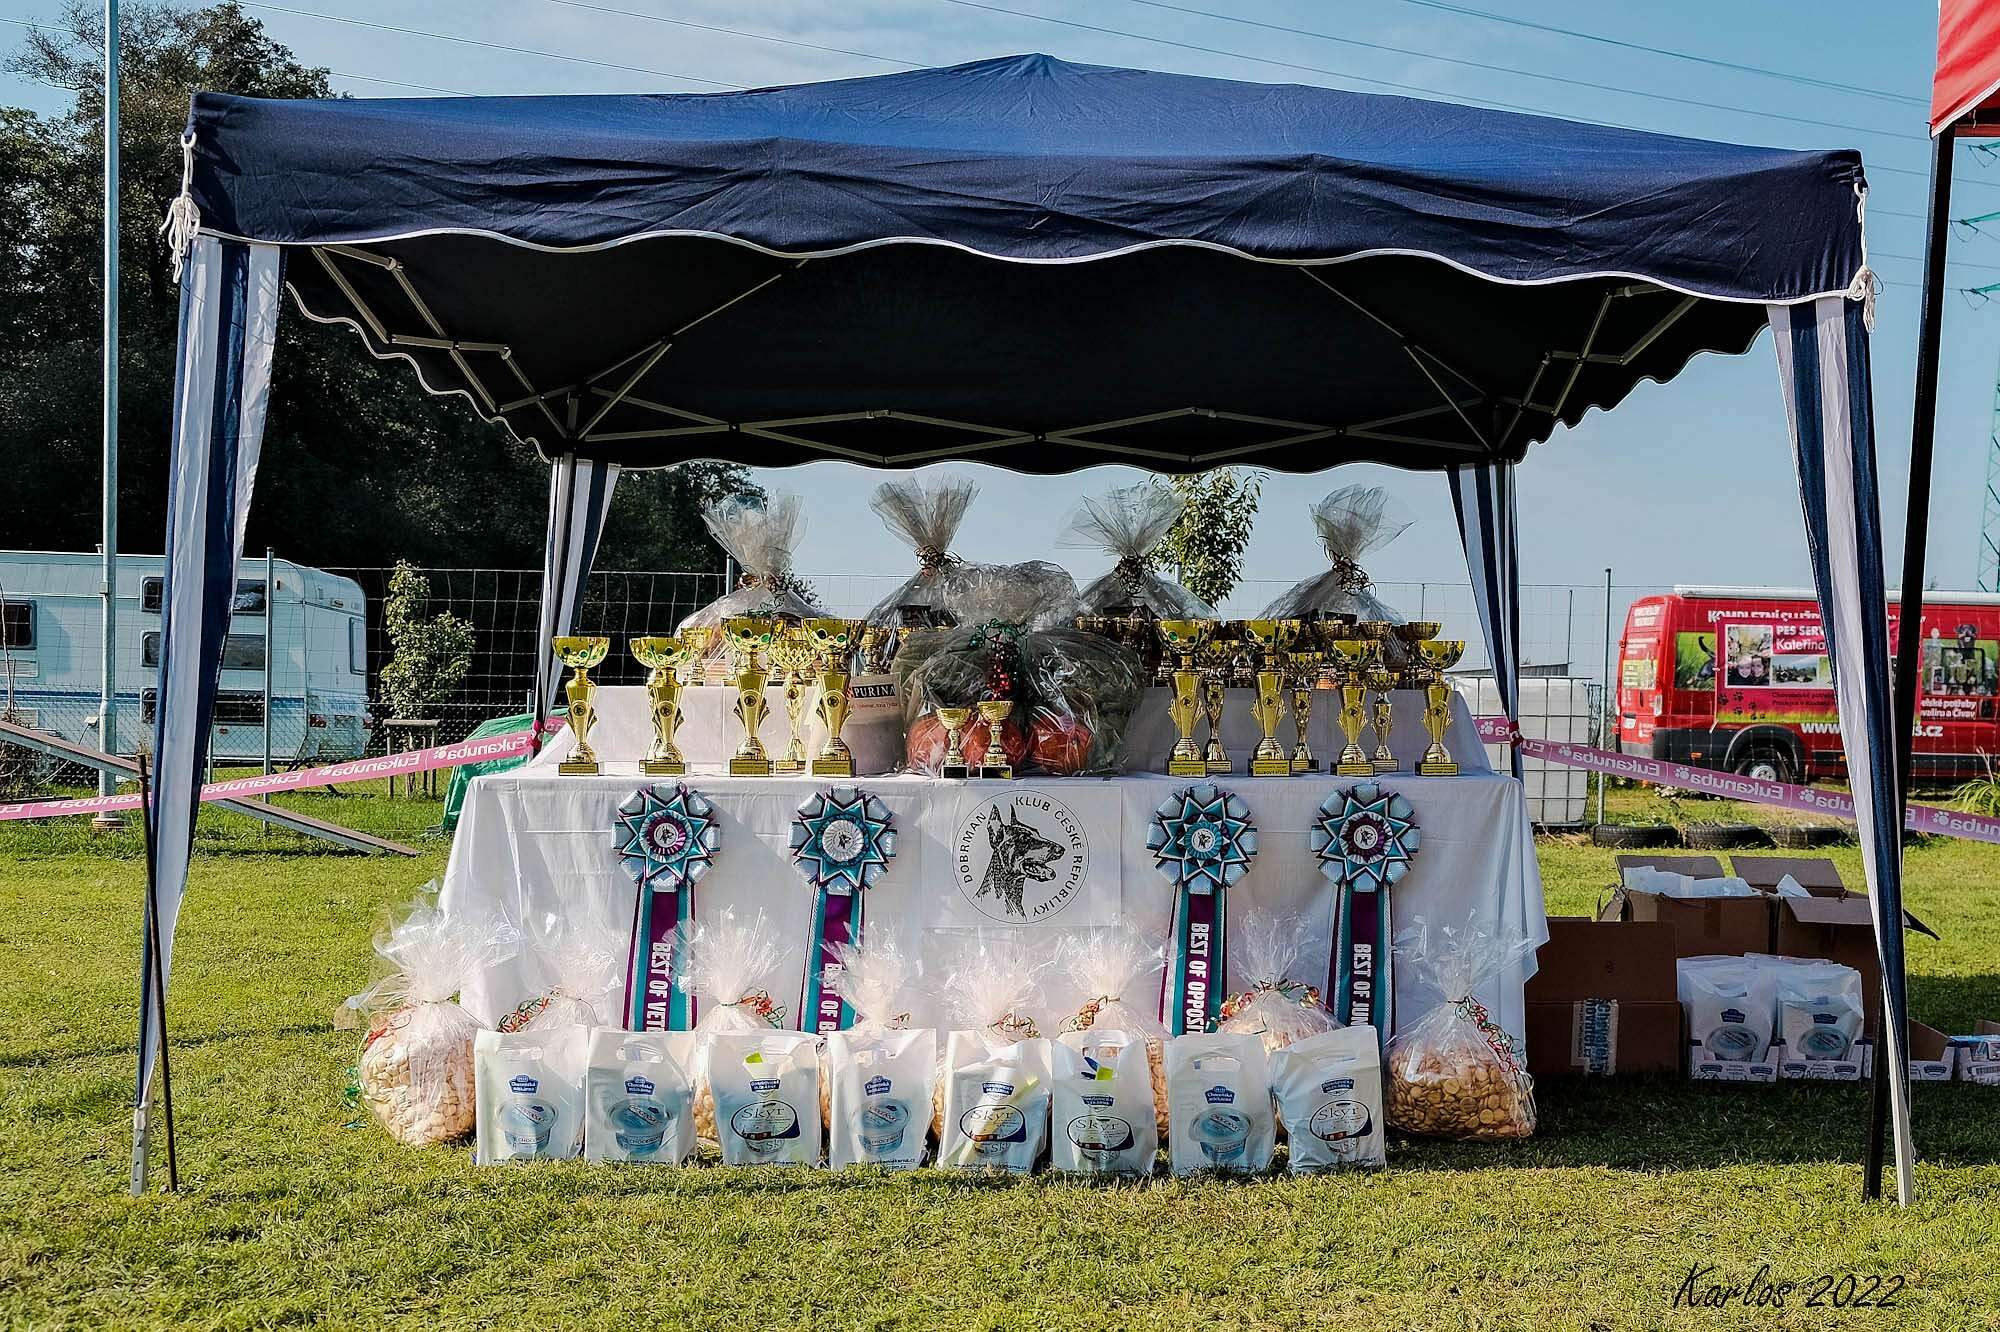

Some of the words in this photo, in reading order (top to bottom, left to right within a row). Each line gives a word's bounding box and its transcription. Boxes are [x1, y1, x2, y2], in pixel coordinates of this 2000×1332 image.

[1776, 625, 1797, 636] PES
[853, 685, 897, 697] PURINA
[1015, 796, 1051, 812] KLUB
[1054, 808, 1085, 850] ČESKÉ
[959, 812, 987, 884] DOBRMAN
[1032, 855, 1083, 917] REPUBLIKY
[1190, 922, 1210, 958] BEST
[650, 942, 671, 977] BEST
[1353, 944, 1372, 978] BEST
[1188, 960, 1207, 979] OF
[648, 980, 669, 998] OF
[1352, 981, 1371, 998] OF
[820, 1000, 839, 1018] OF
[741, 1107, 785, 1120] Skyr
[970, 1109, 1014, 1123] Skyr
[1317, 1107, 1360, 1121] Skyr
[1075, 1119, 1120, 1133] Skyr
